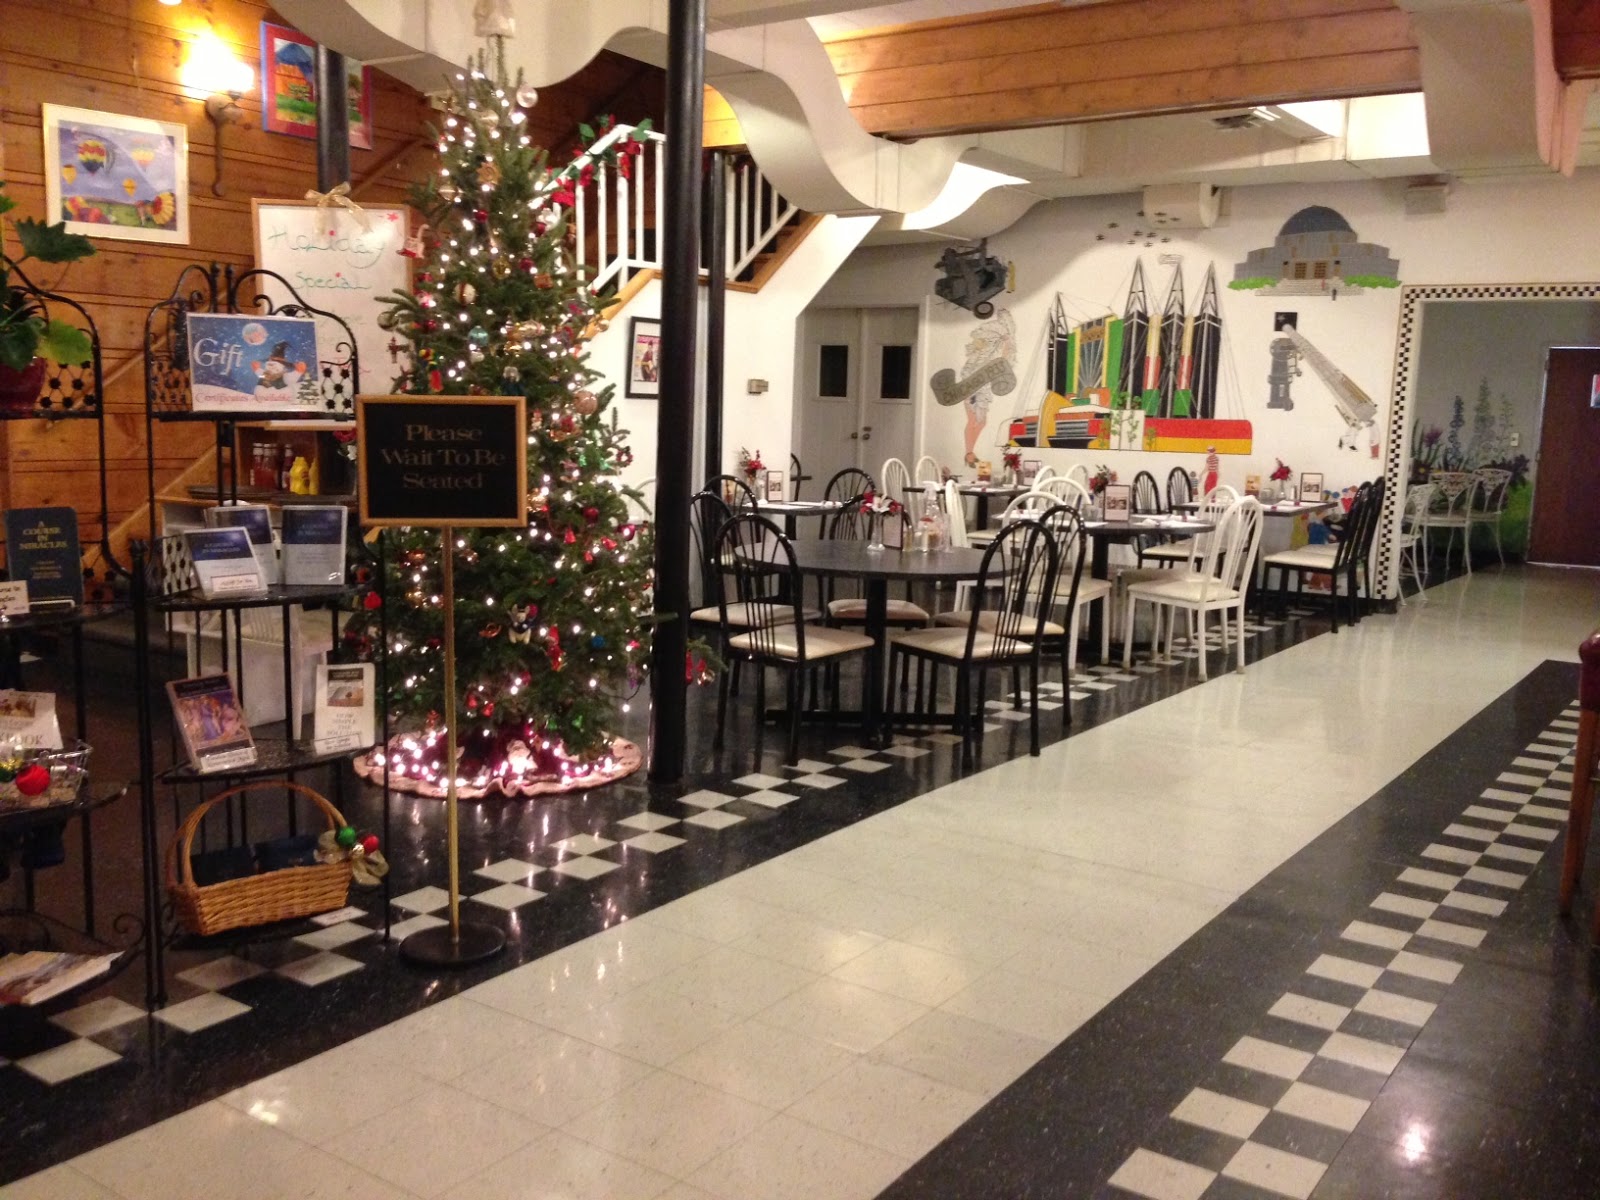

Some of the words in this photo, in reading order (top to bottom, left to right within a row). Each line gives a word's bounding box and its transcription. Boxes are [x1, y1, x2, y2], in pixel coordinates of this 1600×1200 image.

[193, 337, 243, 376] Gift
[405, 424, 482, 442] Please
[380, 448, 434, 466] Wait
[435, 448, 471, 466] To
[474, 448, 506, 466] Be
[402, 472, 483, 489] Seated
